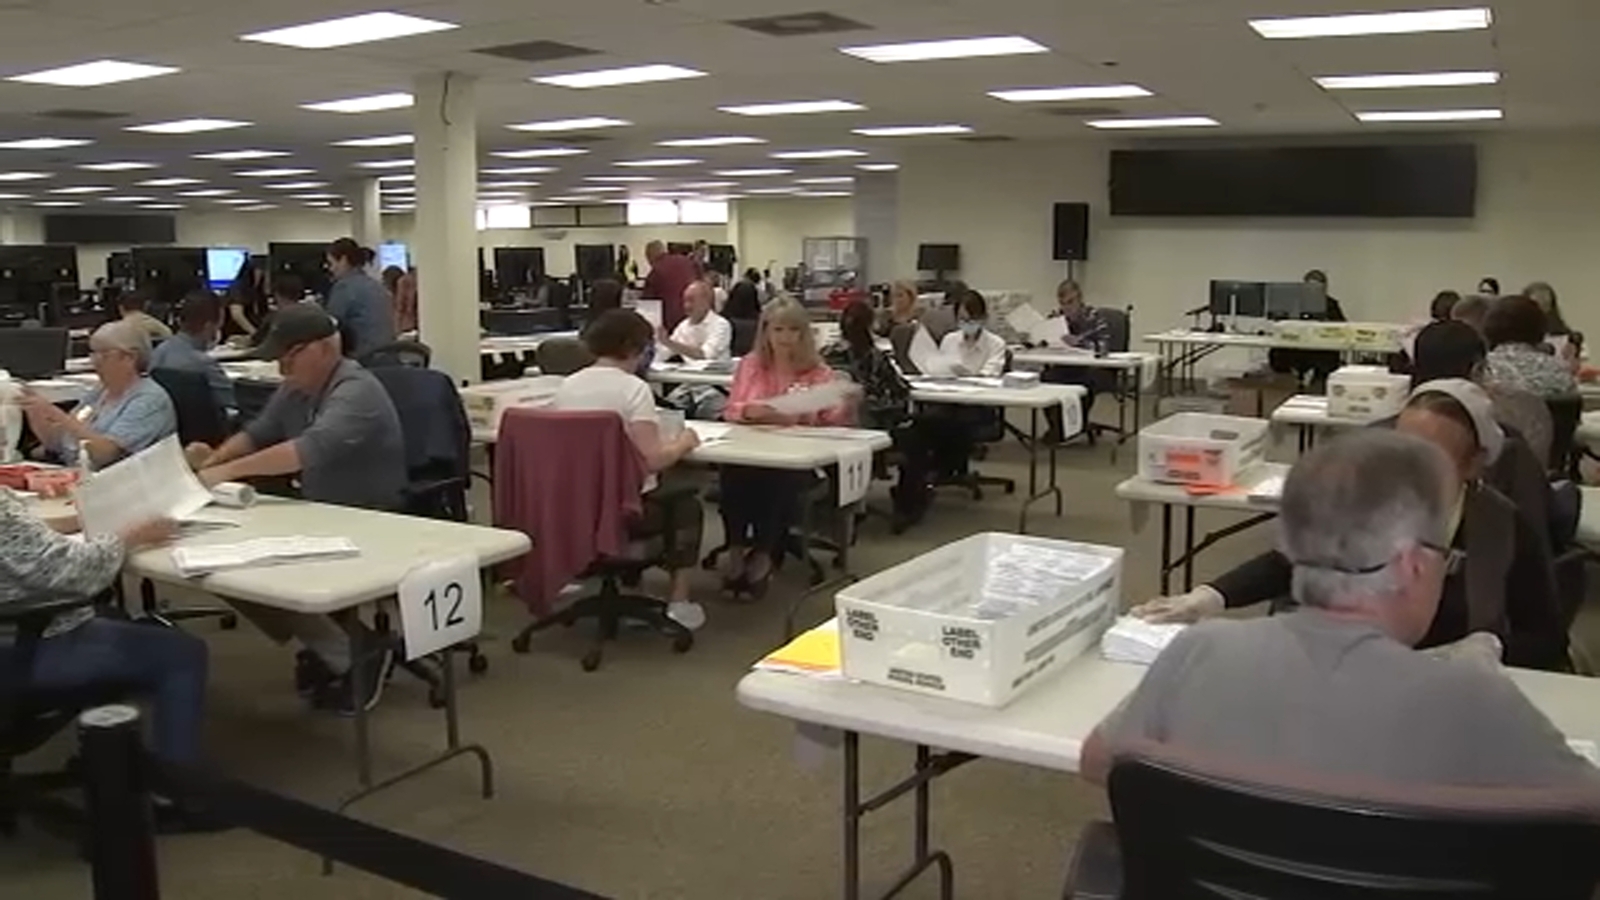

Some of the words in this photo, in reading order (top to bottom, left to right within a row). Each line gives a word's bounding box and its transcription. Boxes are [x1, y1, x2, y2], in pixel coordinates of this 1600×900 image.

[424, 582, 464, 631] 12
[942, 626, 979, 638] LABEL
[942, 637, 981, 650] OTHER
